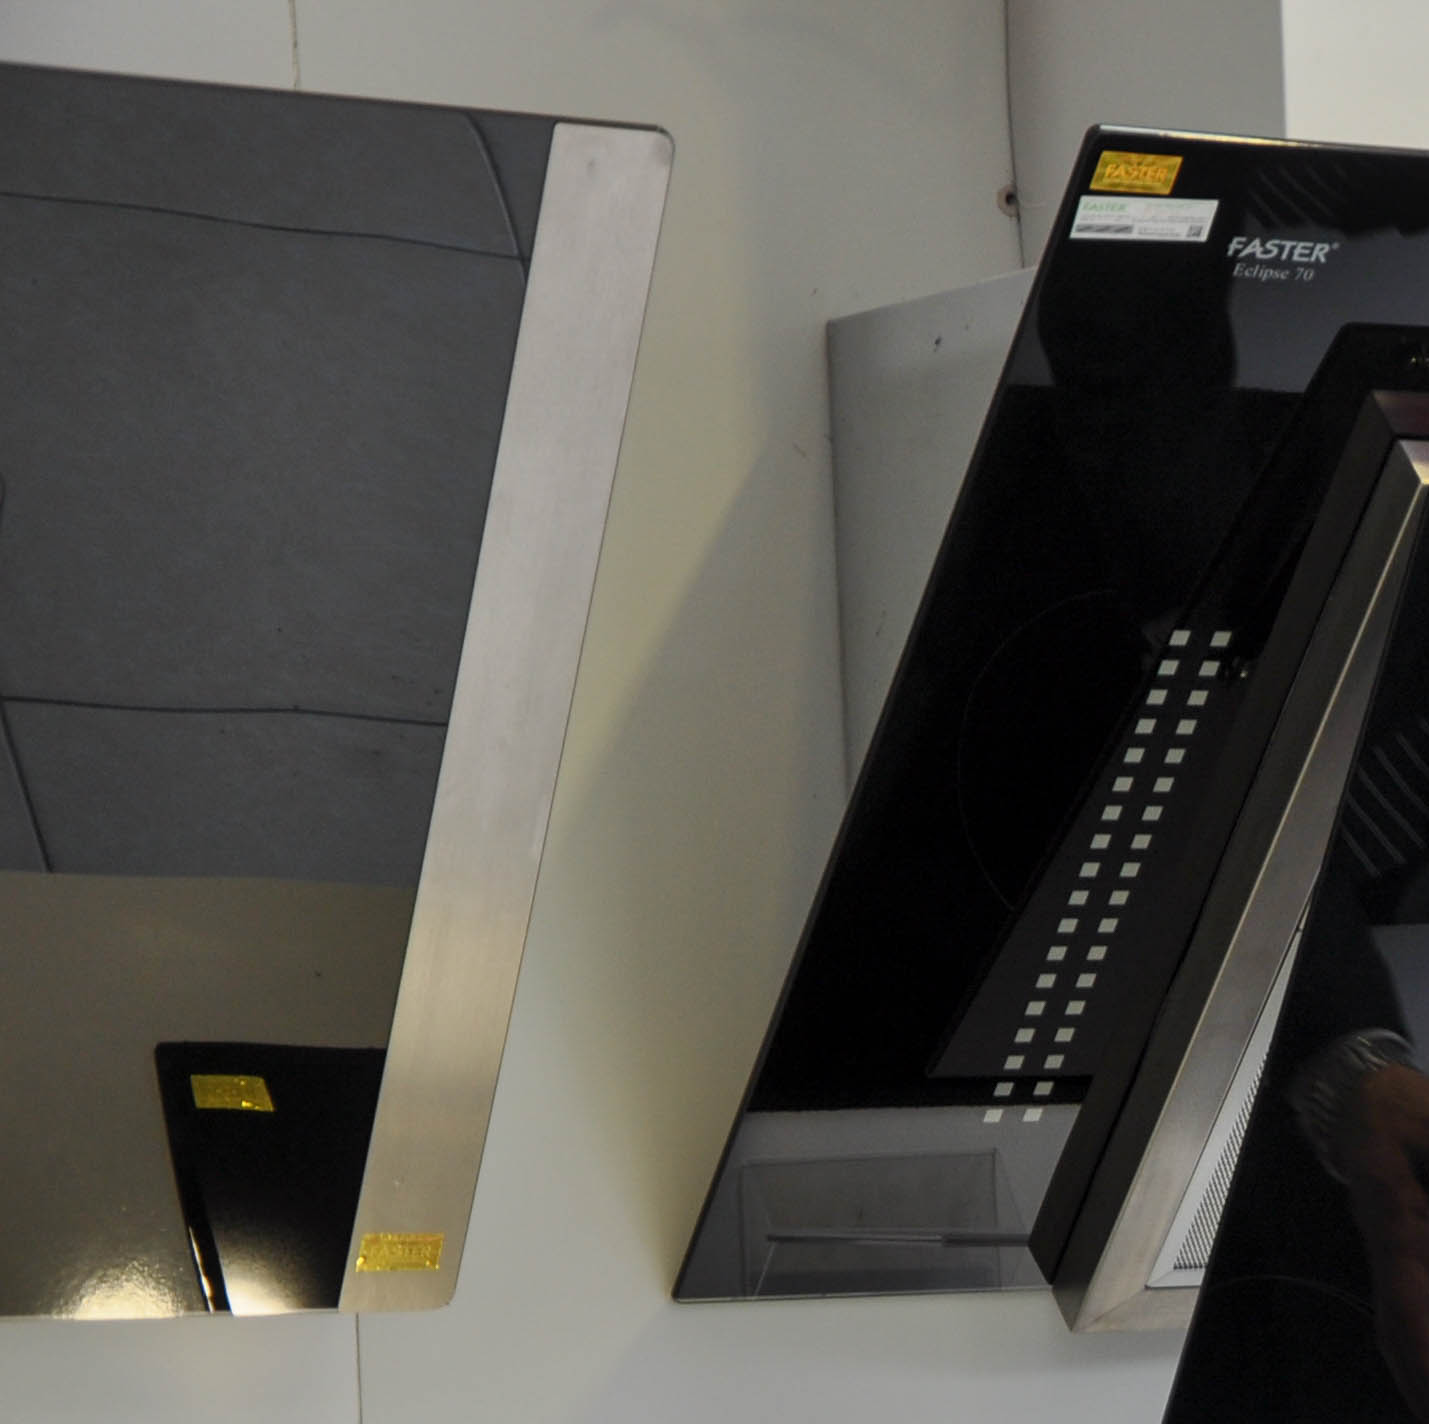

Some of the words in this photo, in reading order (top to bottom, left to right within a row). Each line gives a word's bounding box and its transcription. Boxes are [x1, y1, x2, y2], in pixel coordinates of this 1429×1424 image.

[1226, 236, 1331, 264] FASTER
[1233, 262, 1290, 282] Eclipse
[1294, 267, 1315, 282] 70
